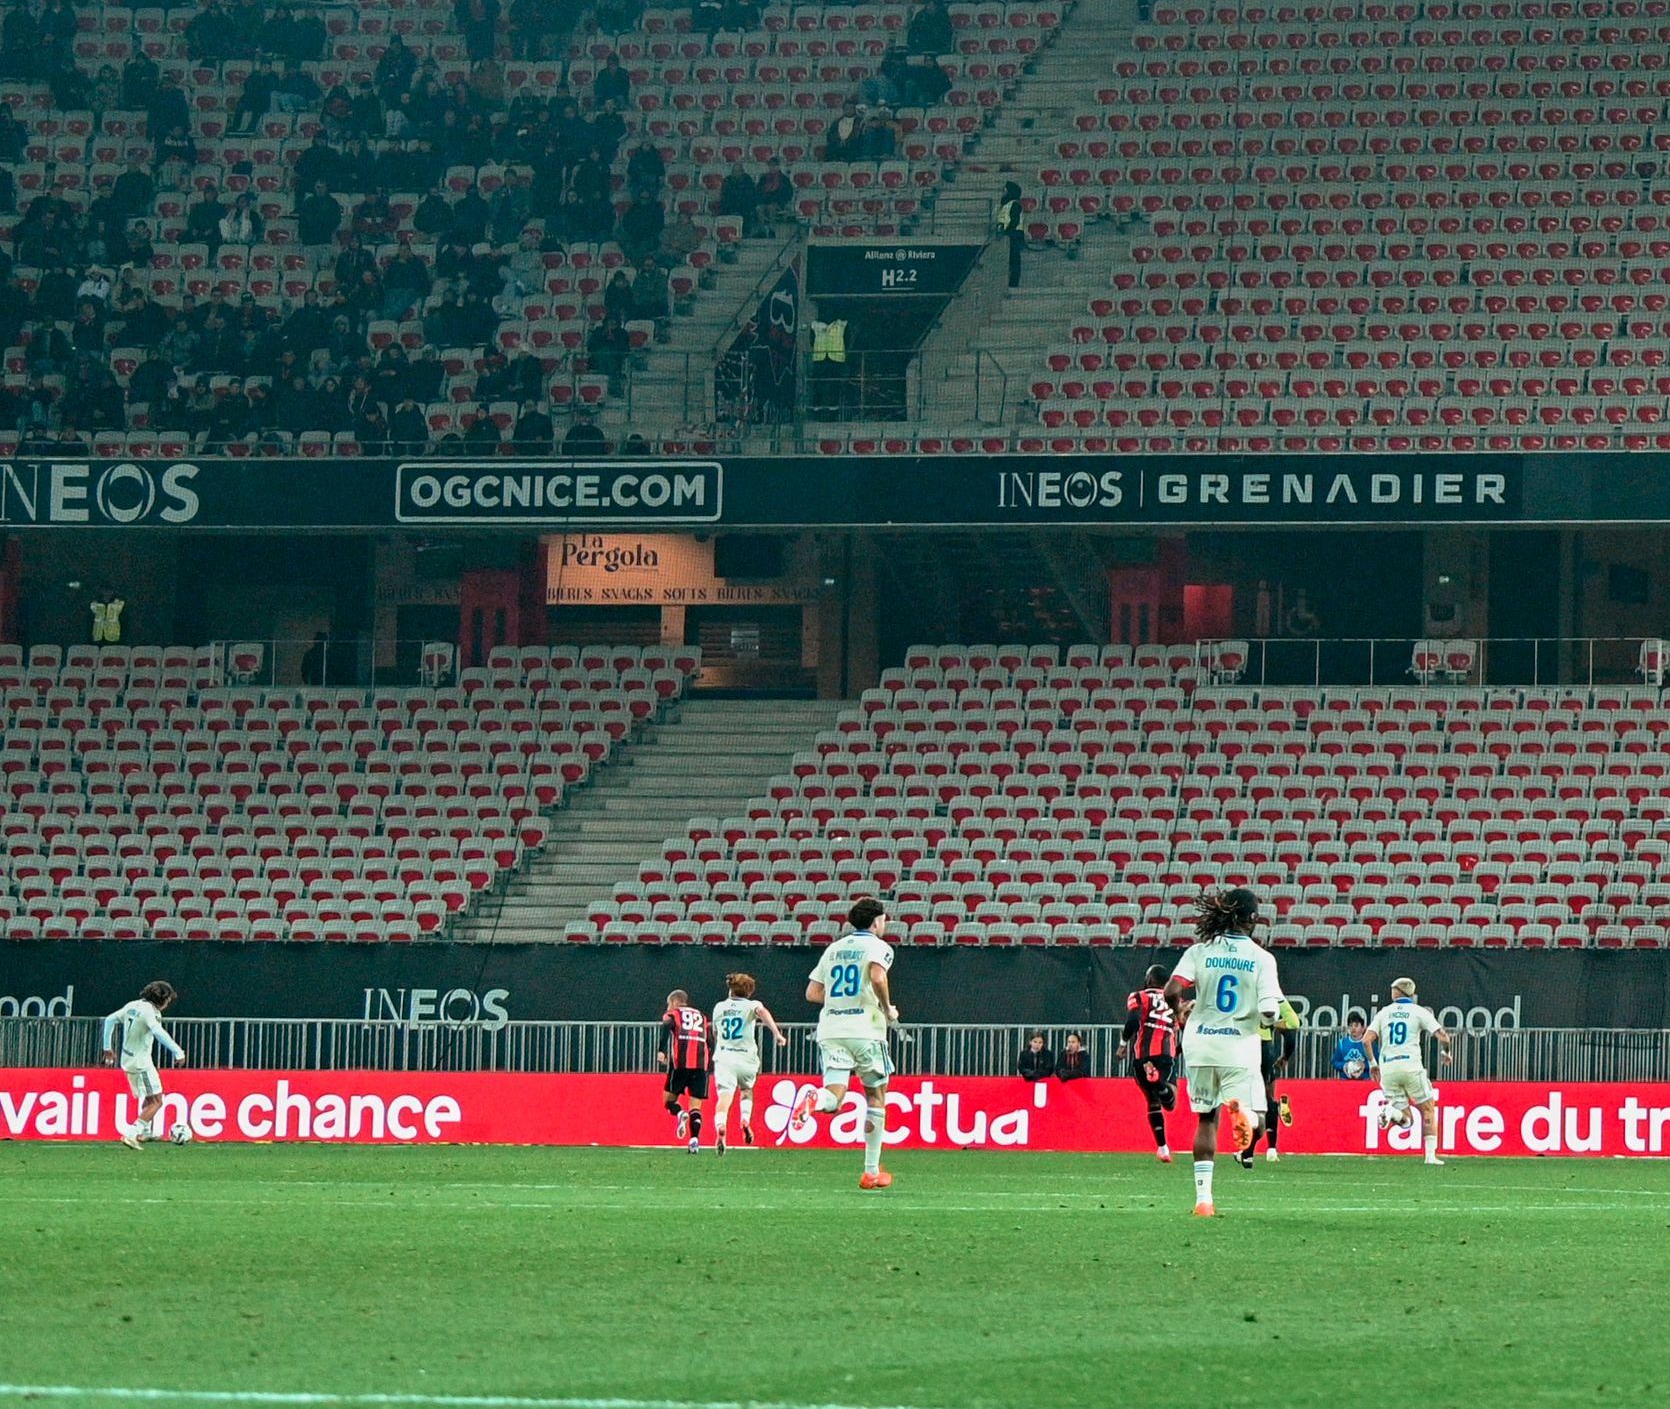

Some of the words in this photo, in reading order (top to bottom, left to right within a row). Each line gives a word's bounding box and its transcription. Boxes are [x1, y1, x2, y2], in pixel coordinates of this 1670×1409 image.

[411, 474, 705, 508] OGCNICE.COM
[998, 470, 1123, 508] INEOS
[1158, 473, 1506, 505] GRENADIER
[562, 543, 659, 572] Pergola
[830, 963, 860, 998] 29
[1205, 957, 1256, 973] DOUKOURE
[363, 987, 510, 1031] INEOS
[1216, 974, 1240, 1013] 6
[681, 1011, 704, 1032] 92
[721, 1017, 744, 1040] 32
[1388, 1021, 1408, 1045] 19
[115, 1091, 227, 1138] une
[237, 1079, 461, 1139] chance
[1520, 1091, 1601, 1153] du
